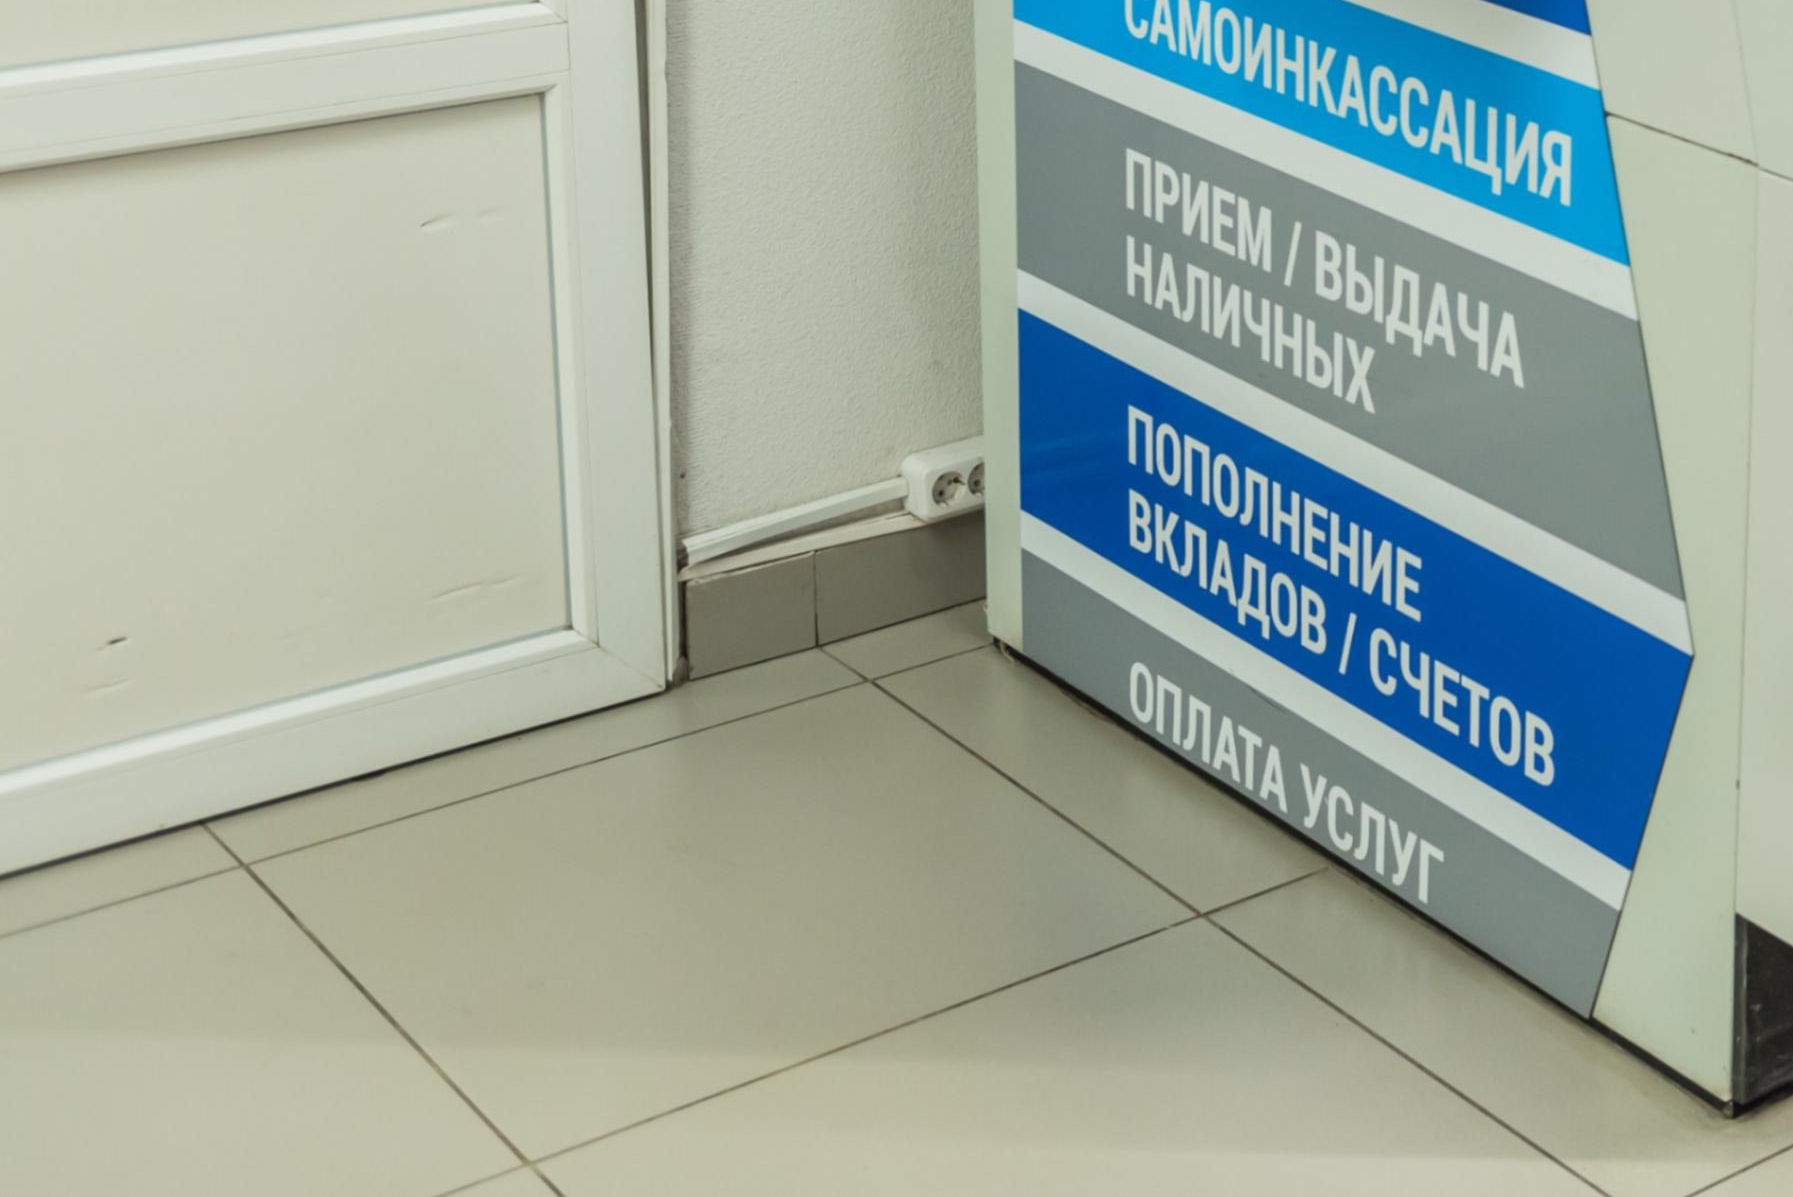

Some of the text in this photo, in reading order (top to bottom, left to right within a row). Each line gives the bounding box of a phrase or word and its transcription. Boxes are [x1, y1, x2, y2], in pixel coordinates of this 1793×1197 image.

[1125, 147, 1272, 273] ПРИЕМ
[1315, 229, 1525, 389] ВЫДАЧА
[1125, 234, 1376, 414] НАЛИЧНЫХ
[1126, 404, 1423, 623] ПОПОЛНЕНИЕ
[1128, 488, 1328, 656] ВКЛАДОВ
[1369, 627, 1556, 787] СЧЕТОВ
[1129, 661, 1445, 905] ОПЛАТА УСЛУГ
